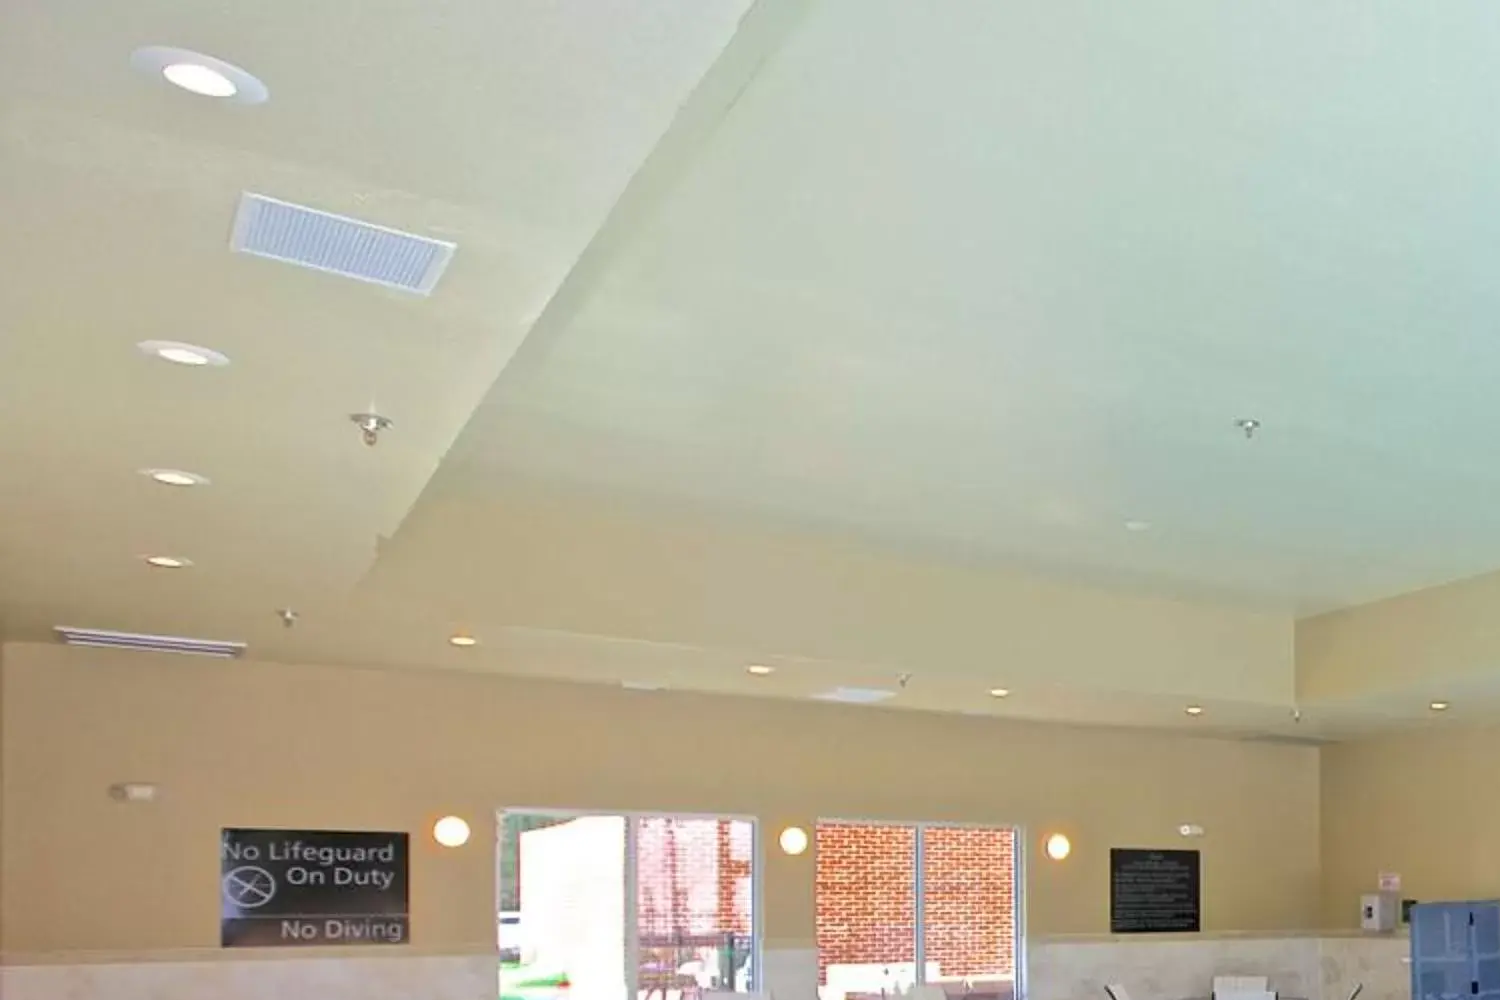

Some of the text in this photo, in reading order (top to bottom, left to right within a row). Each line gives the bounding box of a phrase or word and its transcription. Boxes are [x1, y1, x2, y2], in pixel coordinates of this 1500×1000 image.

[222, 840, 394, 866] No Lifeguard
[286, 866, 395, 889] On Duty
[280, 918, 403, 943] No Diving
